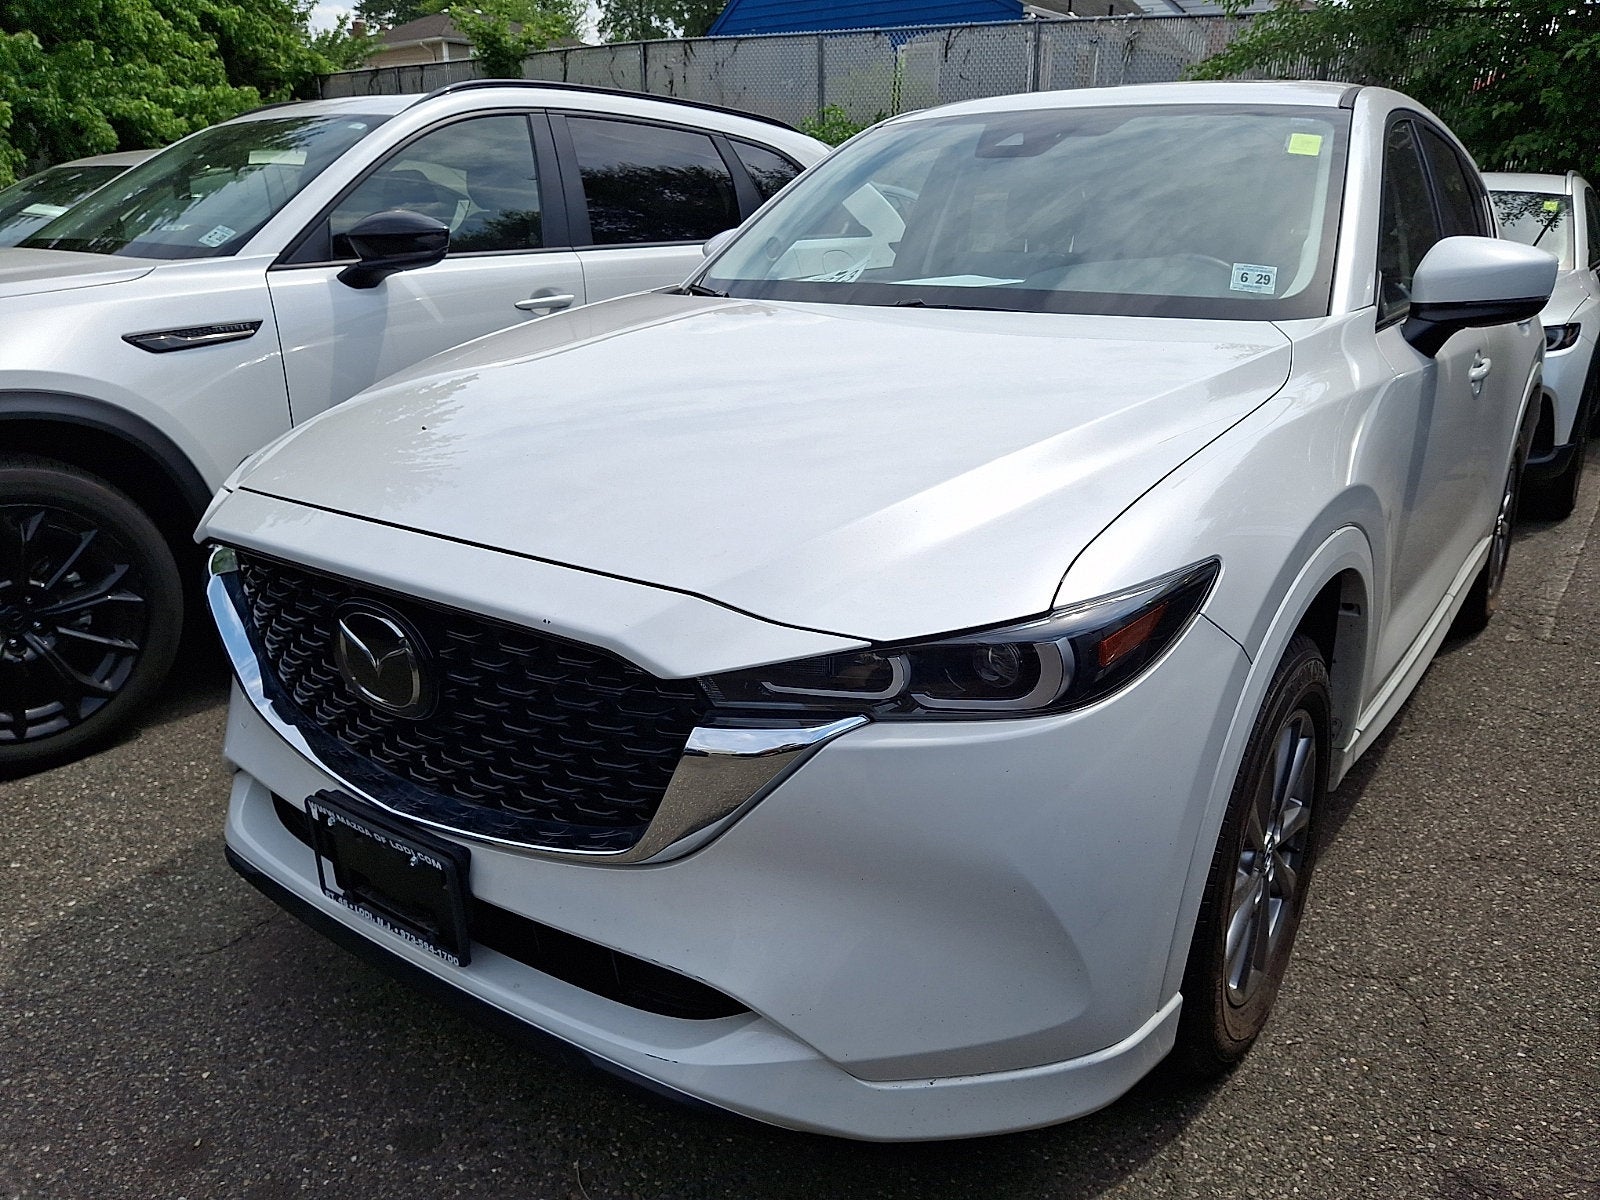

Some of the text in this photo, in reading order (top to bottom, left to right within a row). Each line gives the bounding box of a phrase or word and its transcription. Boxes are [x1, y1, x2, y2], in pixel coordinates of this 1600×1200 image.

[1240, 272, 1271, 285] 6 29
[373, 833, 387, 844] OF
[389, 839, 442, 870] LODICOM
